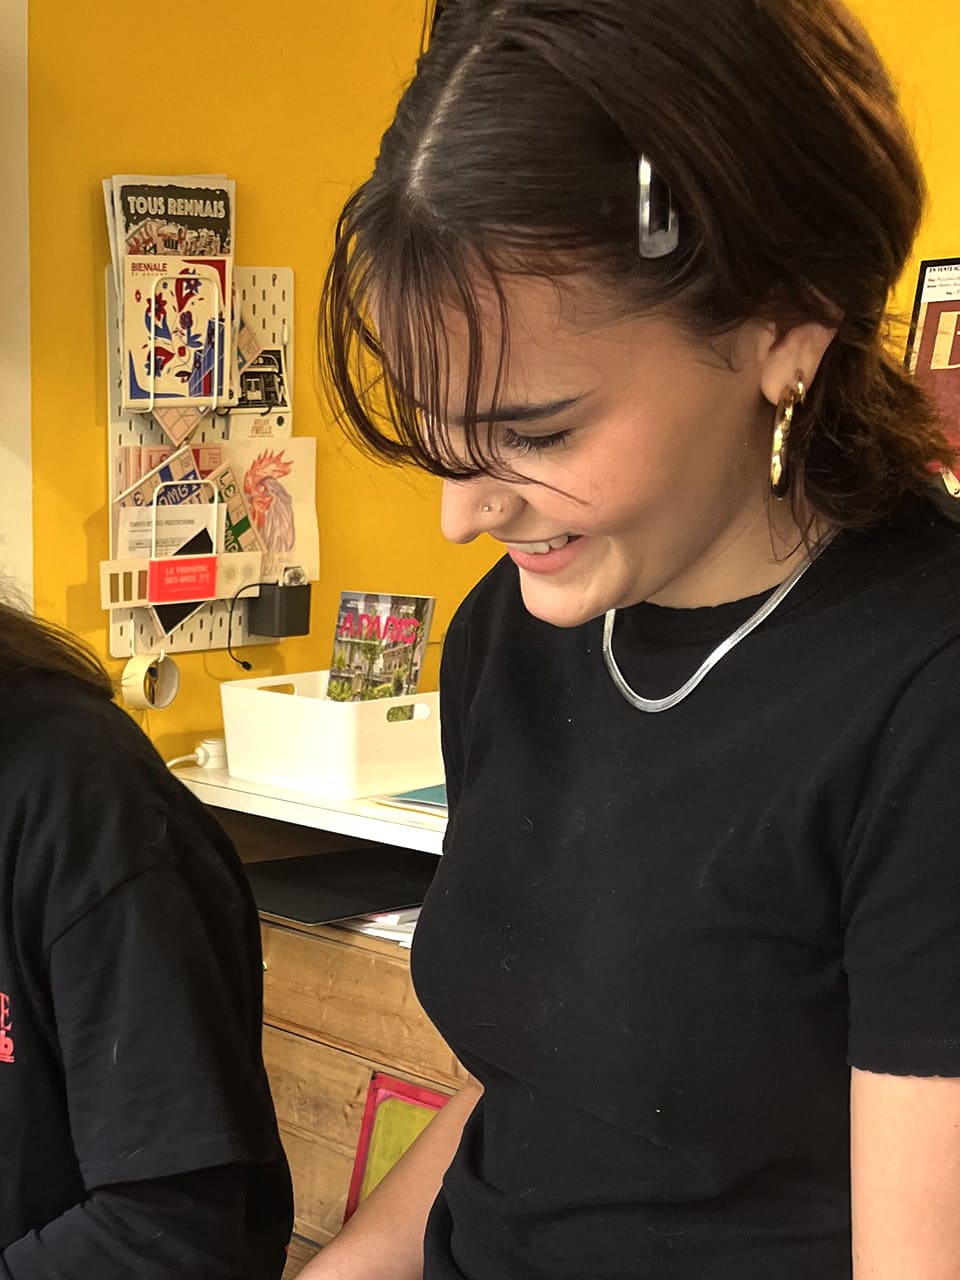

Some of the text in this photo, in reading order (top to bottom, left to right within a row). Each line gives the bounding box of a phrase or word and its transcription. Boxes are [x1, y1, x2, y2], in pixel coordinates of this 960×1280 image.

[127, 196, 226, 218] TOUS RENNAIS
[131, 263, 168, 272] BIENNALE
